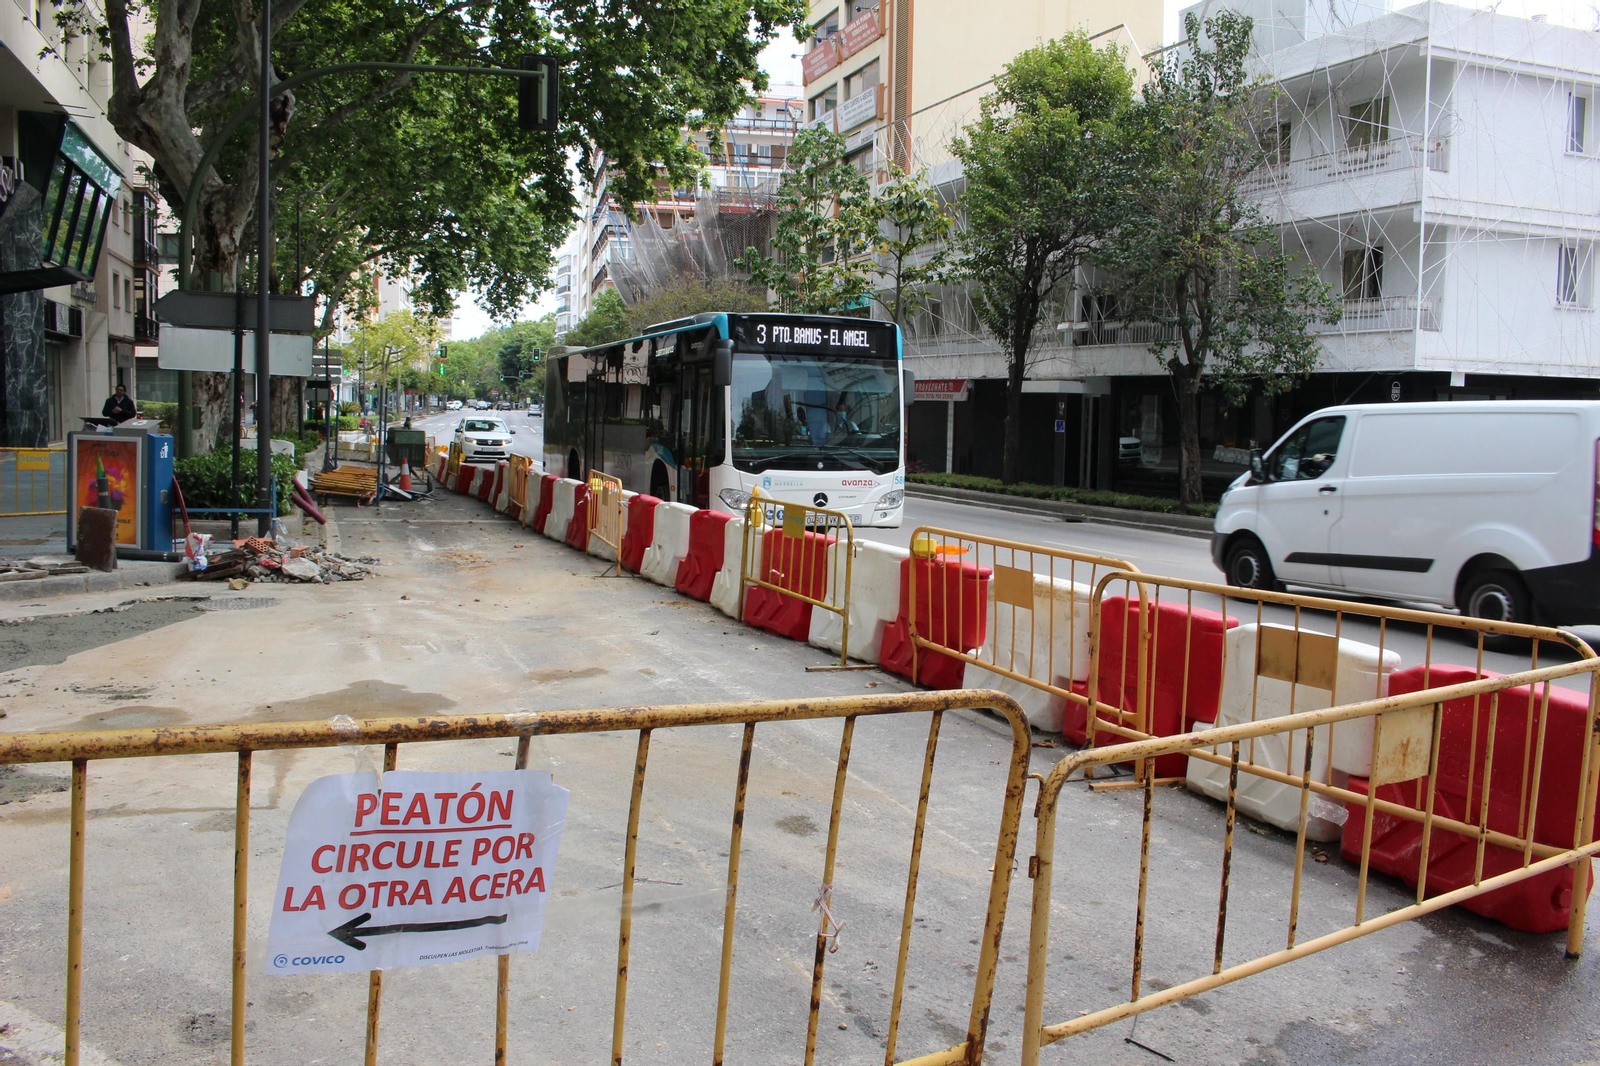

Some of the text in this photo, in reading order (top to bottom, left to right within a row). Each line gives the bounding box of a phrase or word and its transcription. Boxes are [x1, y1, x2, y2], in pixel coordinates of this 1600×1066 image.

[756, 324, 767, 344] 3
[772, 326, 792, 343] PTO.
[793, 327, 822, 345] BANUS
[829, 329, 841, 346] EL
[842, 330, 870, 347] ANGEL
[841, 479, 873, 487] avanza
[354, 782, 514, 827] PEATÓN
[311, 832, 535, 874] CIRCULE POR
[282, 867, 546, 912] LA OTRA ACERA
[291, 954, 345, 966] COVICO
